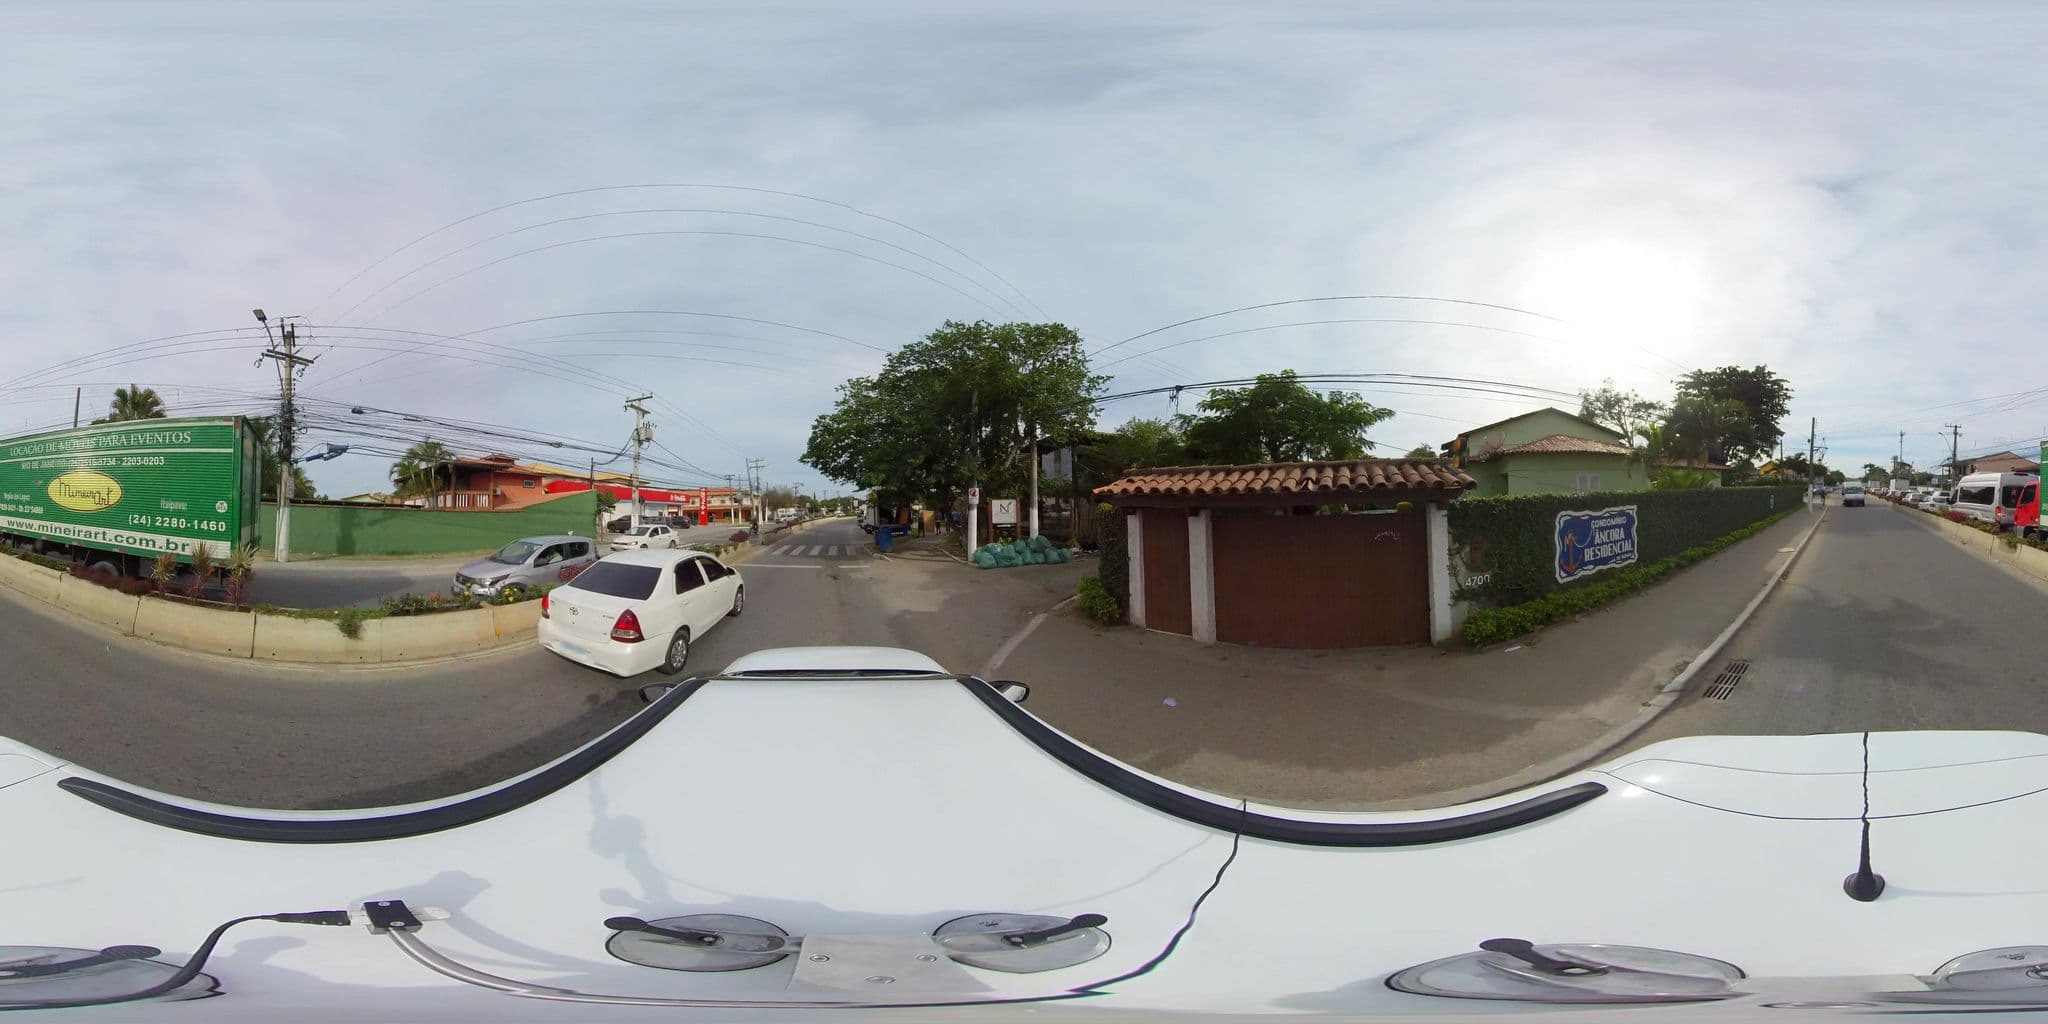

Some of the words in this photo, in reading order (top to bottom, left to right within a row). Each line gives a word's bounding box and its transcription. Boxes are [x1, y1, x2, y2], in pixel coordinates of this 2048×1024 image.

[46, 441, 57, 453] DE
[99, 434, 127, 448] PARA
[131, 431, 191, 446] EVENTOS
[122, 456, 165, 466] 2203-0203
[128, 514, 151, 528] (24)
[155, 516, 226, 532] 2280-1460
[7, 519, 190, 553] www.mineirart.com.br
[1594, 527, 1625, 545] ÂNCORA
[1584, 539, 1634, 562] RESIDENCIAL
